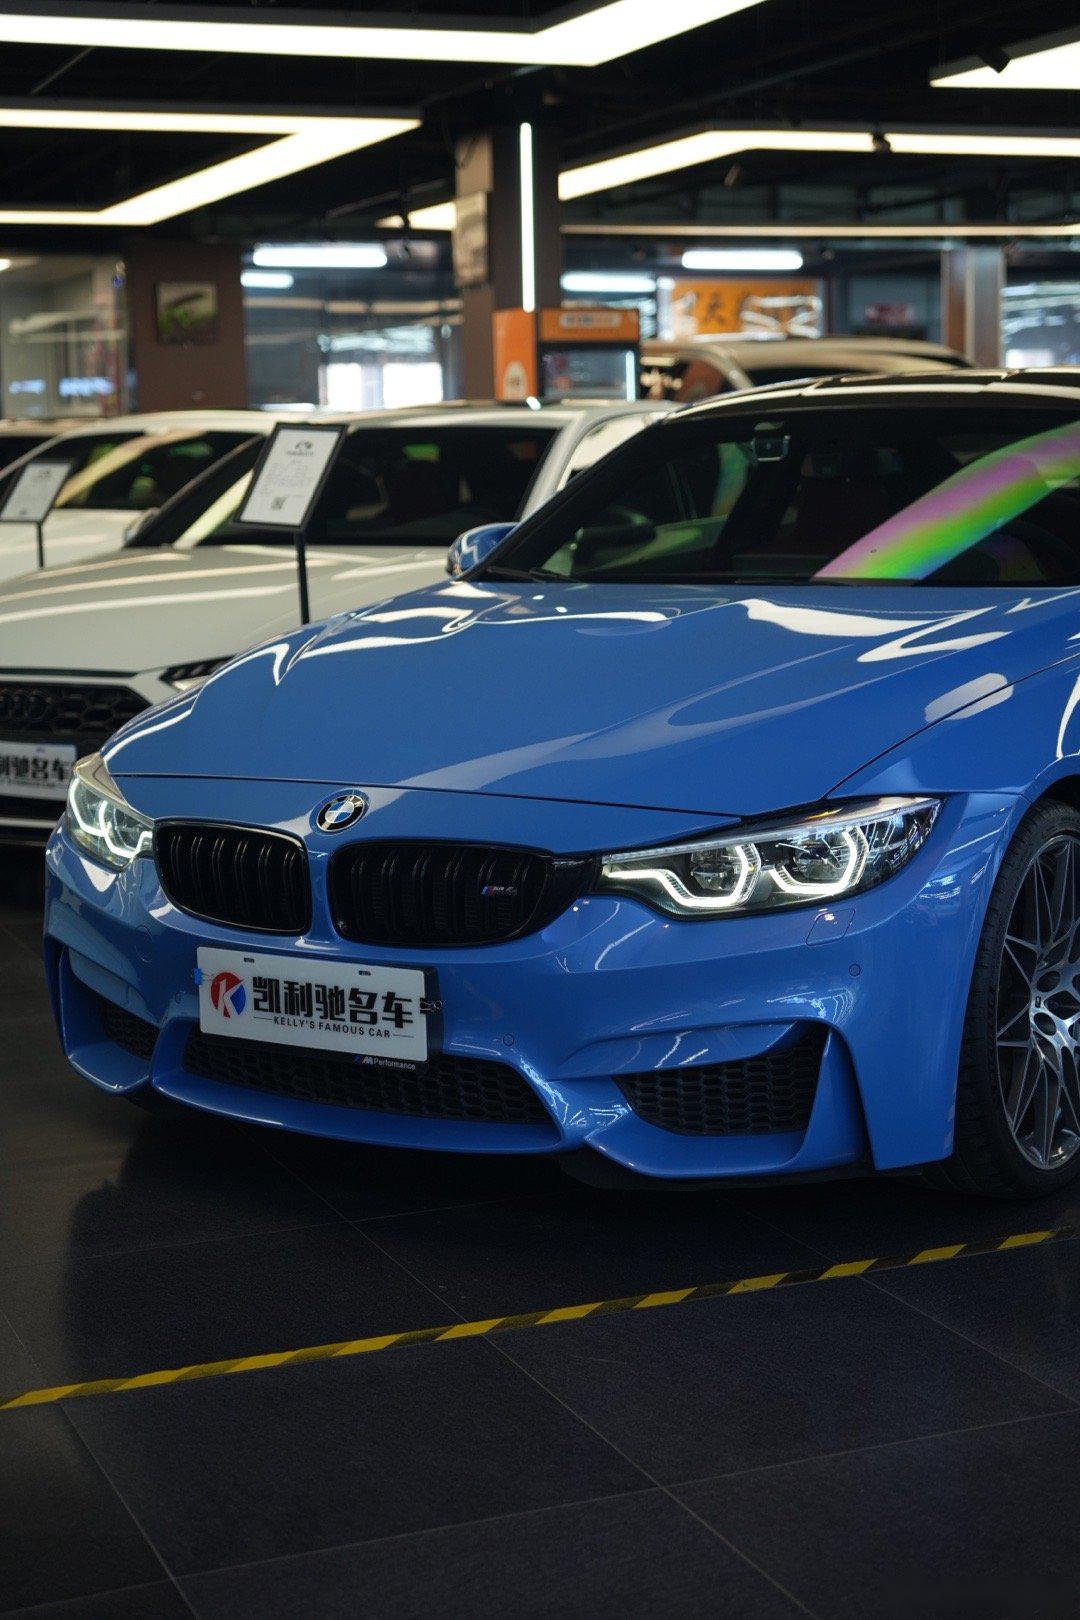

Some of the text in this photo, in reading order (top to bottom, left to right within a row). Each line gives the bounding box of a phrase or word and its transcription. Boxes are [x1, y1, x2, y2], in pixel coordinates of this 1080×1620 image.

[252, 976, 414, 1029] 凯利驰名车
[273, 1016, 391, 1038] KELLY'S FAMOUS CAR
[373, 1057, 416, 1070] Performance
